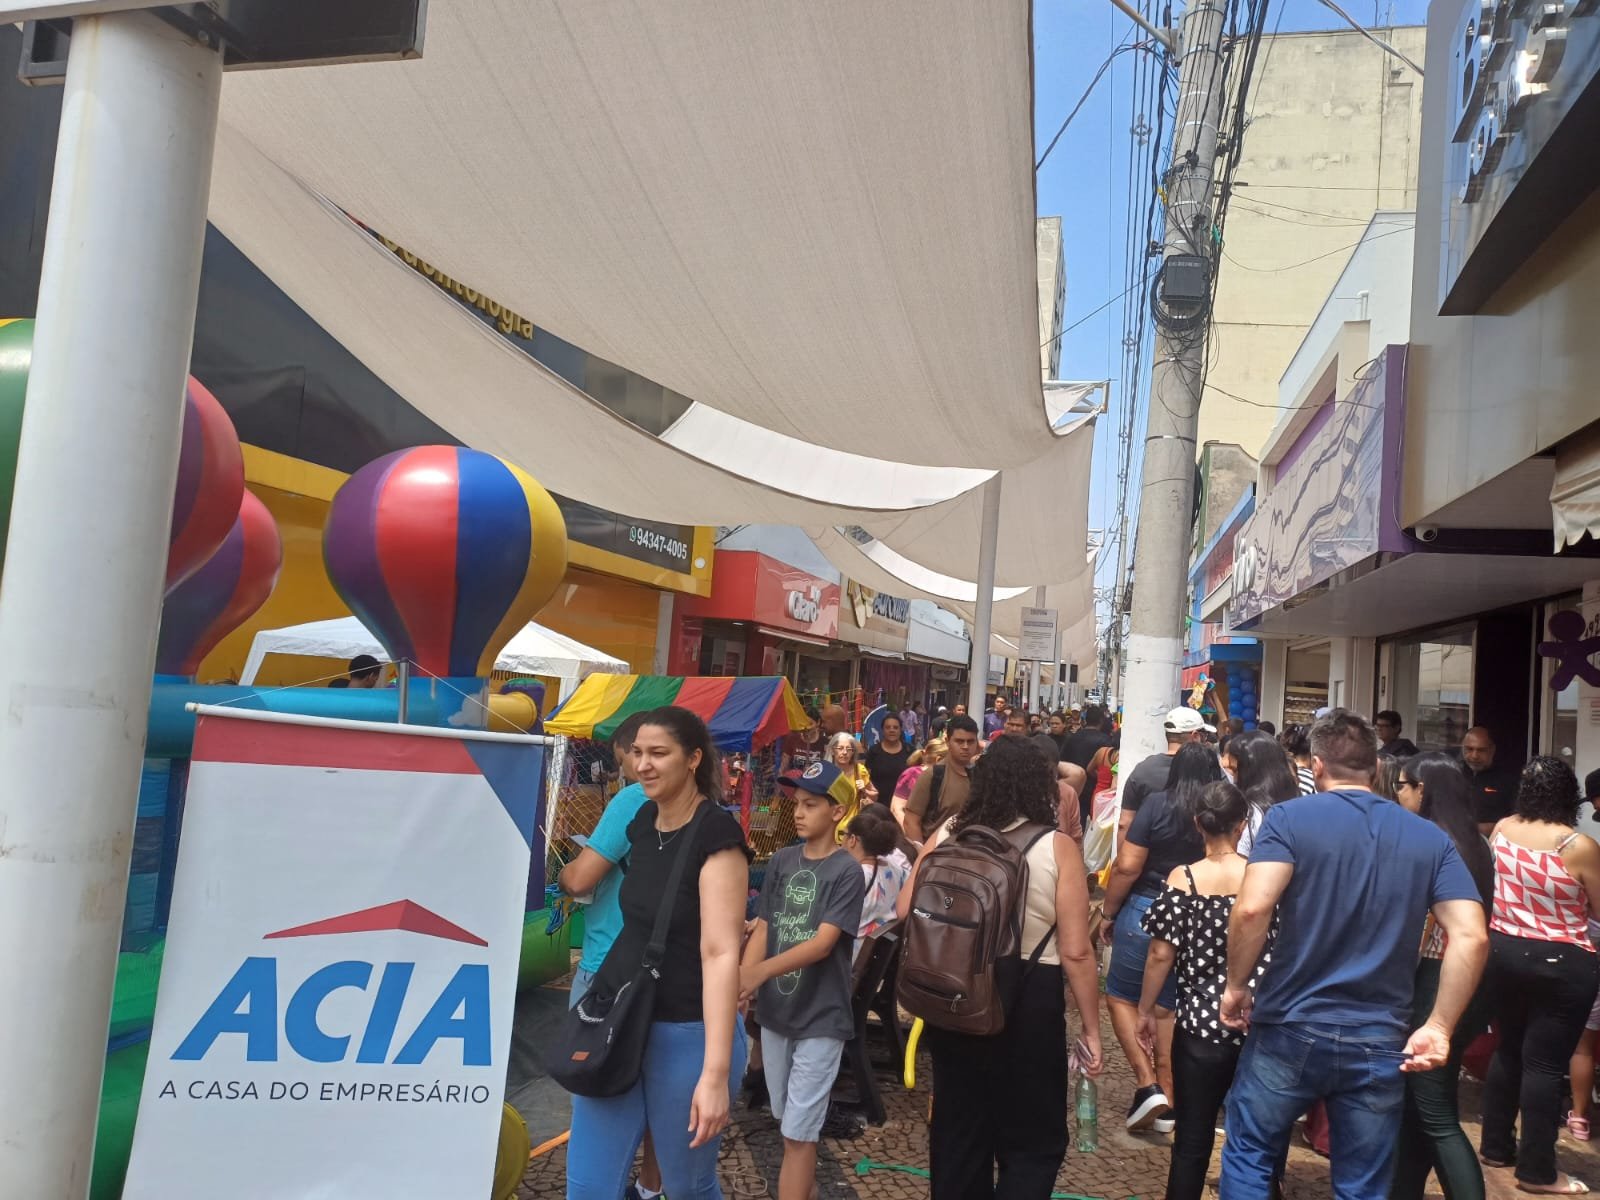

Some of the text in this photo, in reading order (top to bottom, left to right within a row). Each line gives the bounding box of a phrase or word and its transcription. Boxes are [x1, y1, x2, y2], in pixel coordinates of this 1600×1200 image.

[637, 528, 687, 559] 94347-4005
[170, 957, 492, 1067] ACIA
[159, 1079, 490, 1104] A CASA DO EMPRESÁRIO
